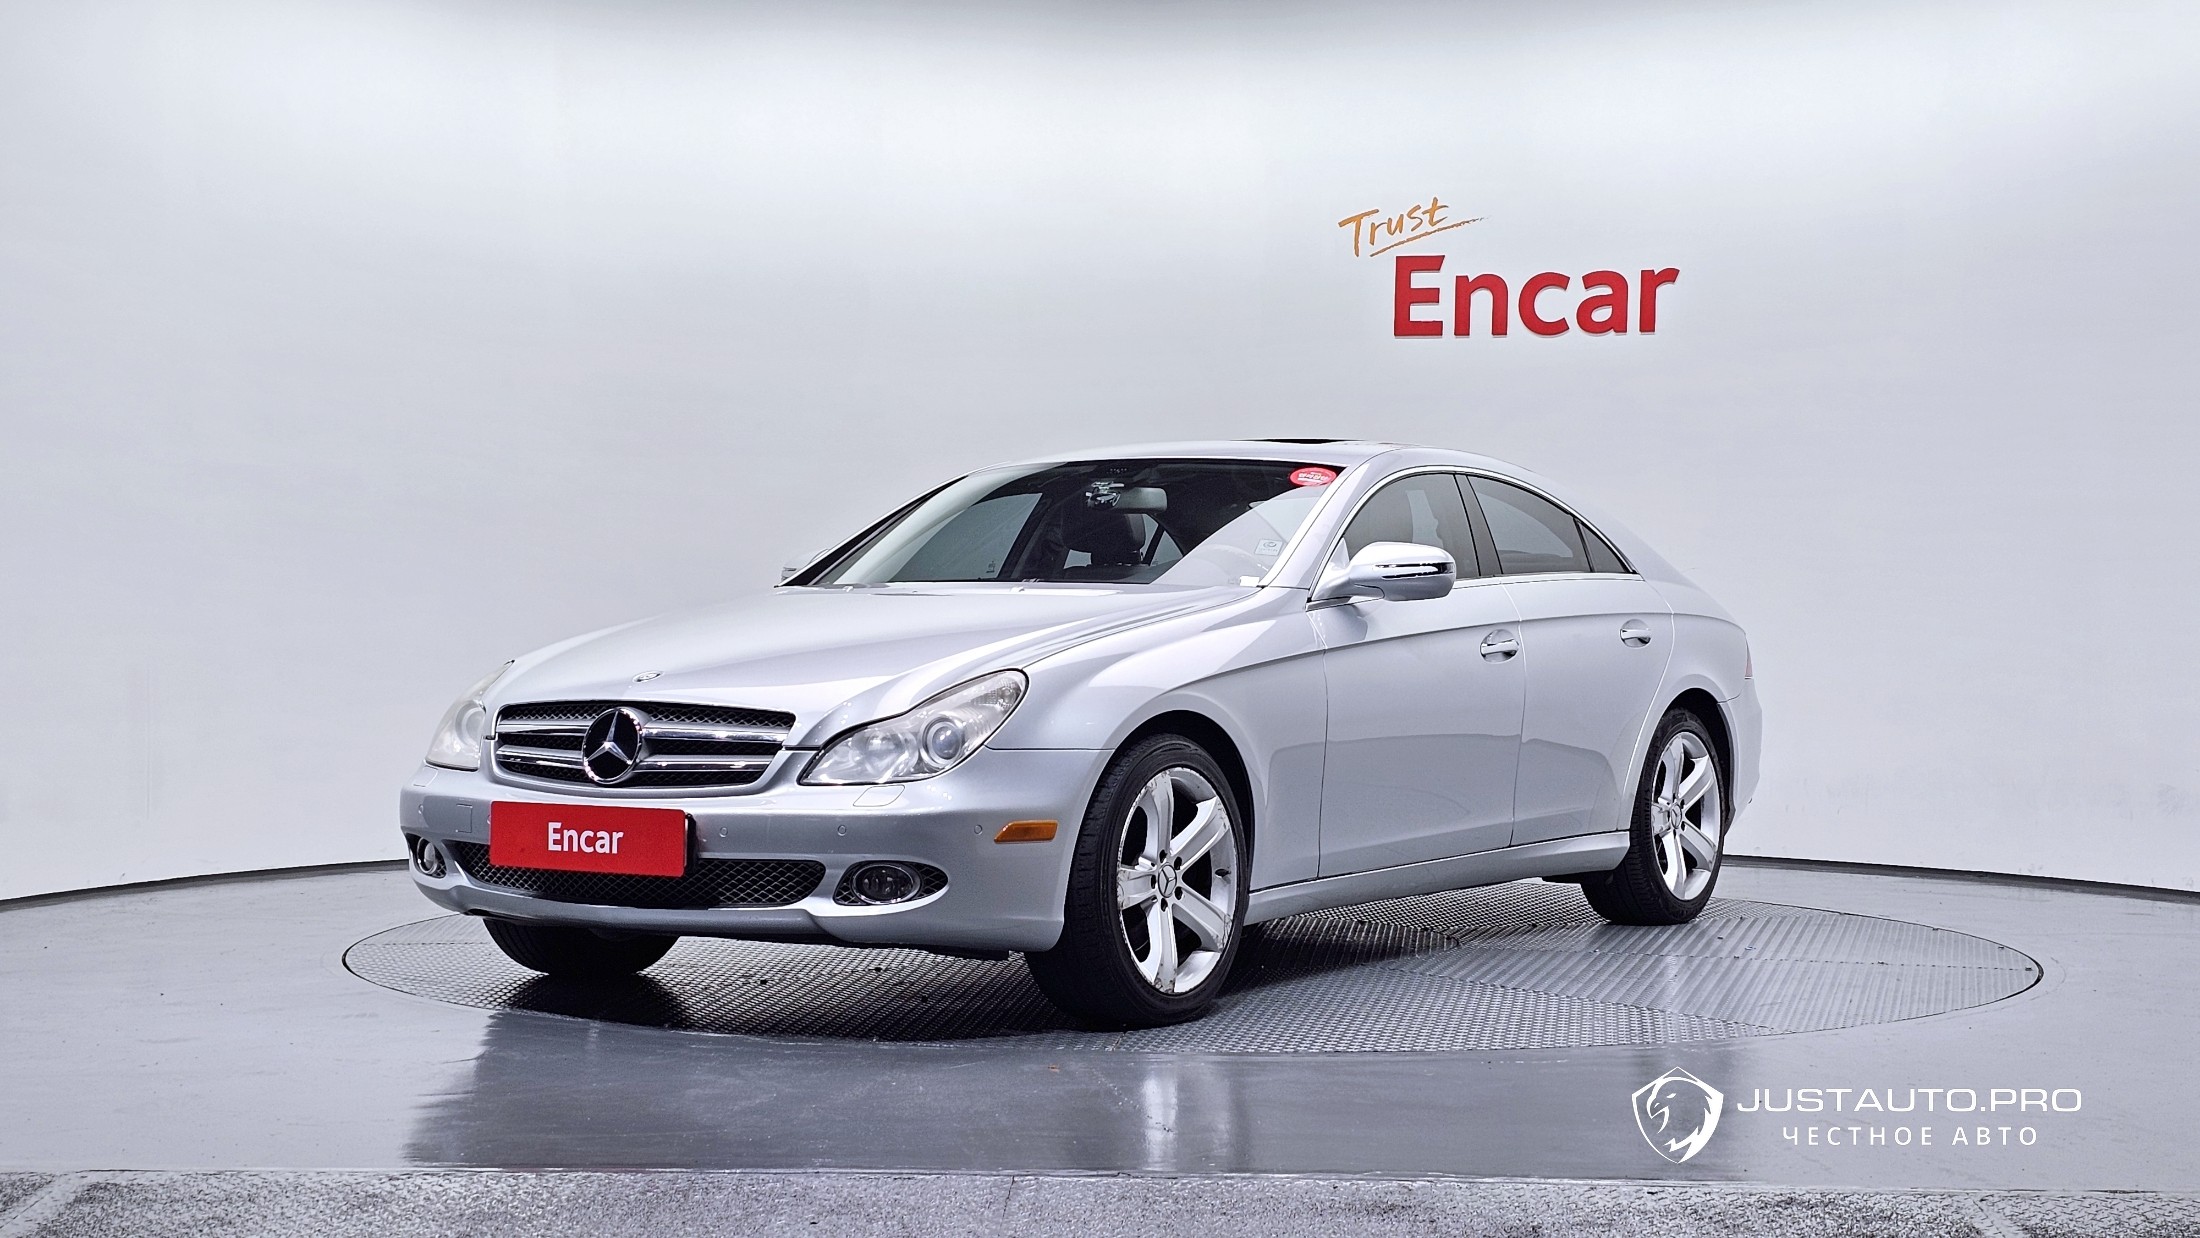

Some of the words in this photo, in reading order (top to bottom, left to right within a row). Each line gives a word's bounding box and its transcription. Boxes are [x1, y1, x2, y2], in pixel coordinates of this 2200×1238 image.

[1338, 197, 1450, 258] Trust
[1394, 255, 1680, 337] Encar
[547, 821, 624, 854] Encar
